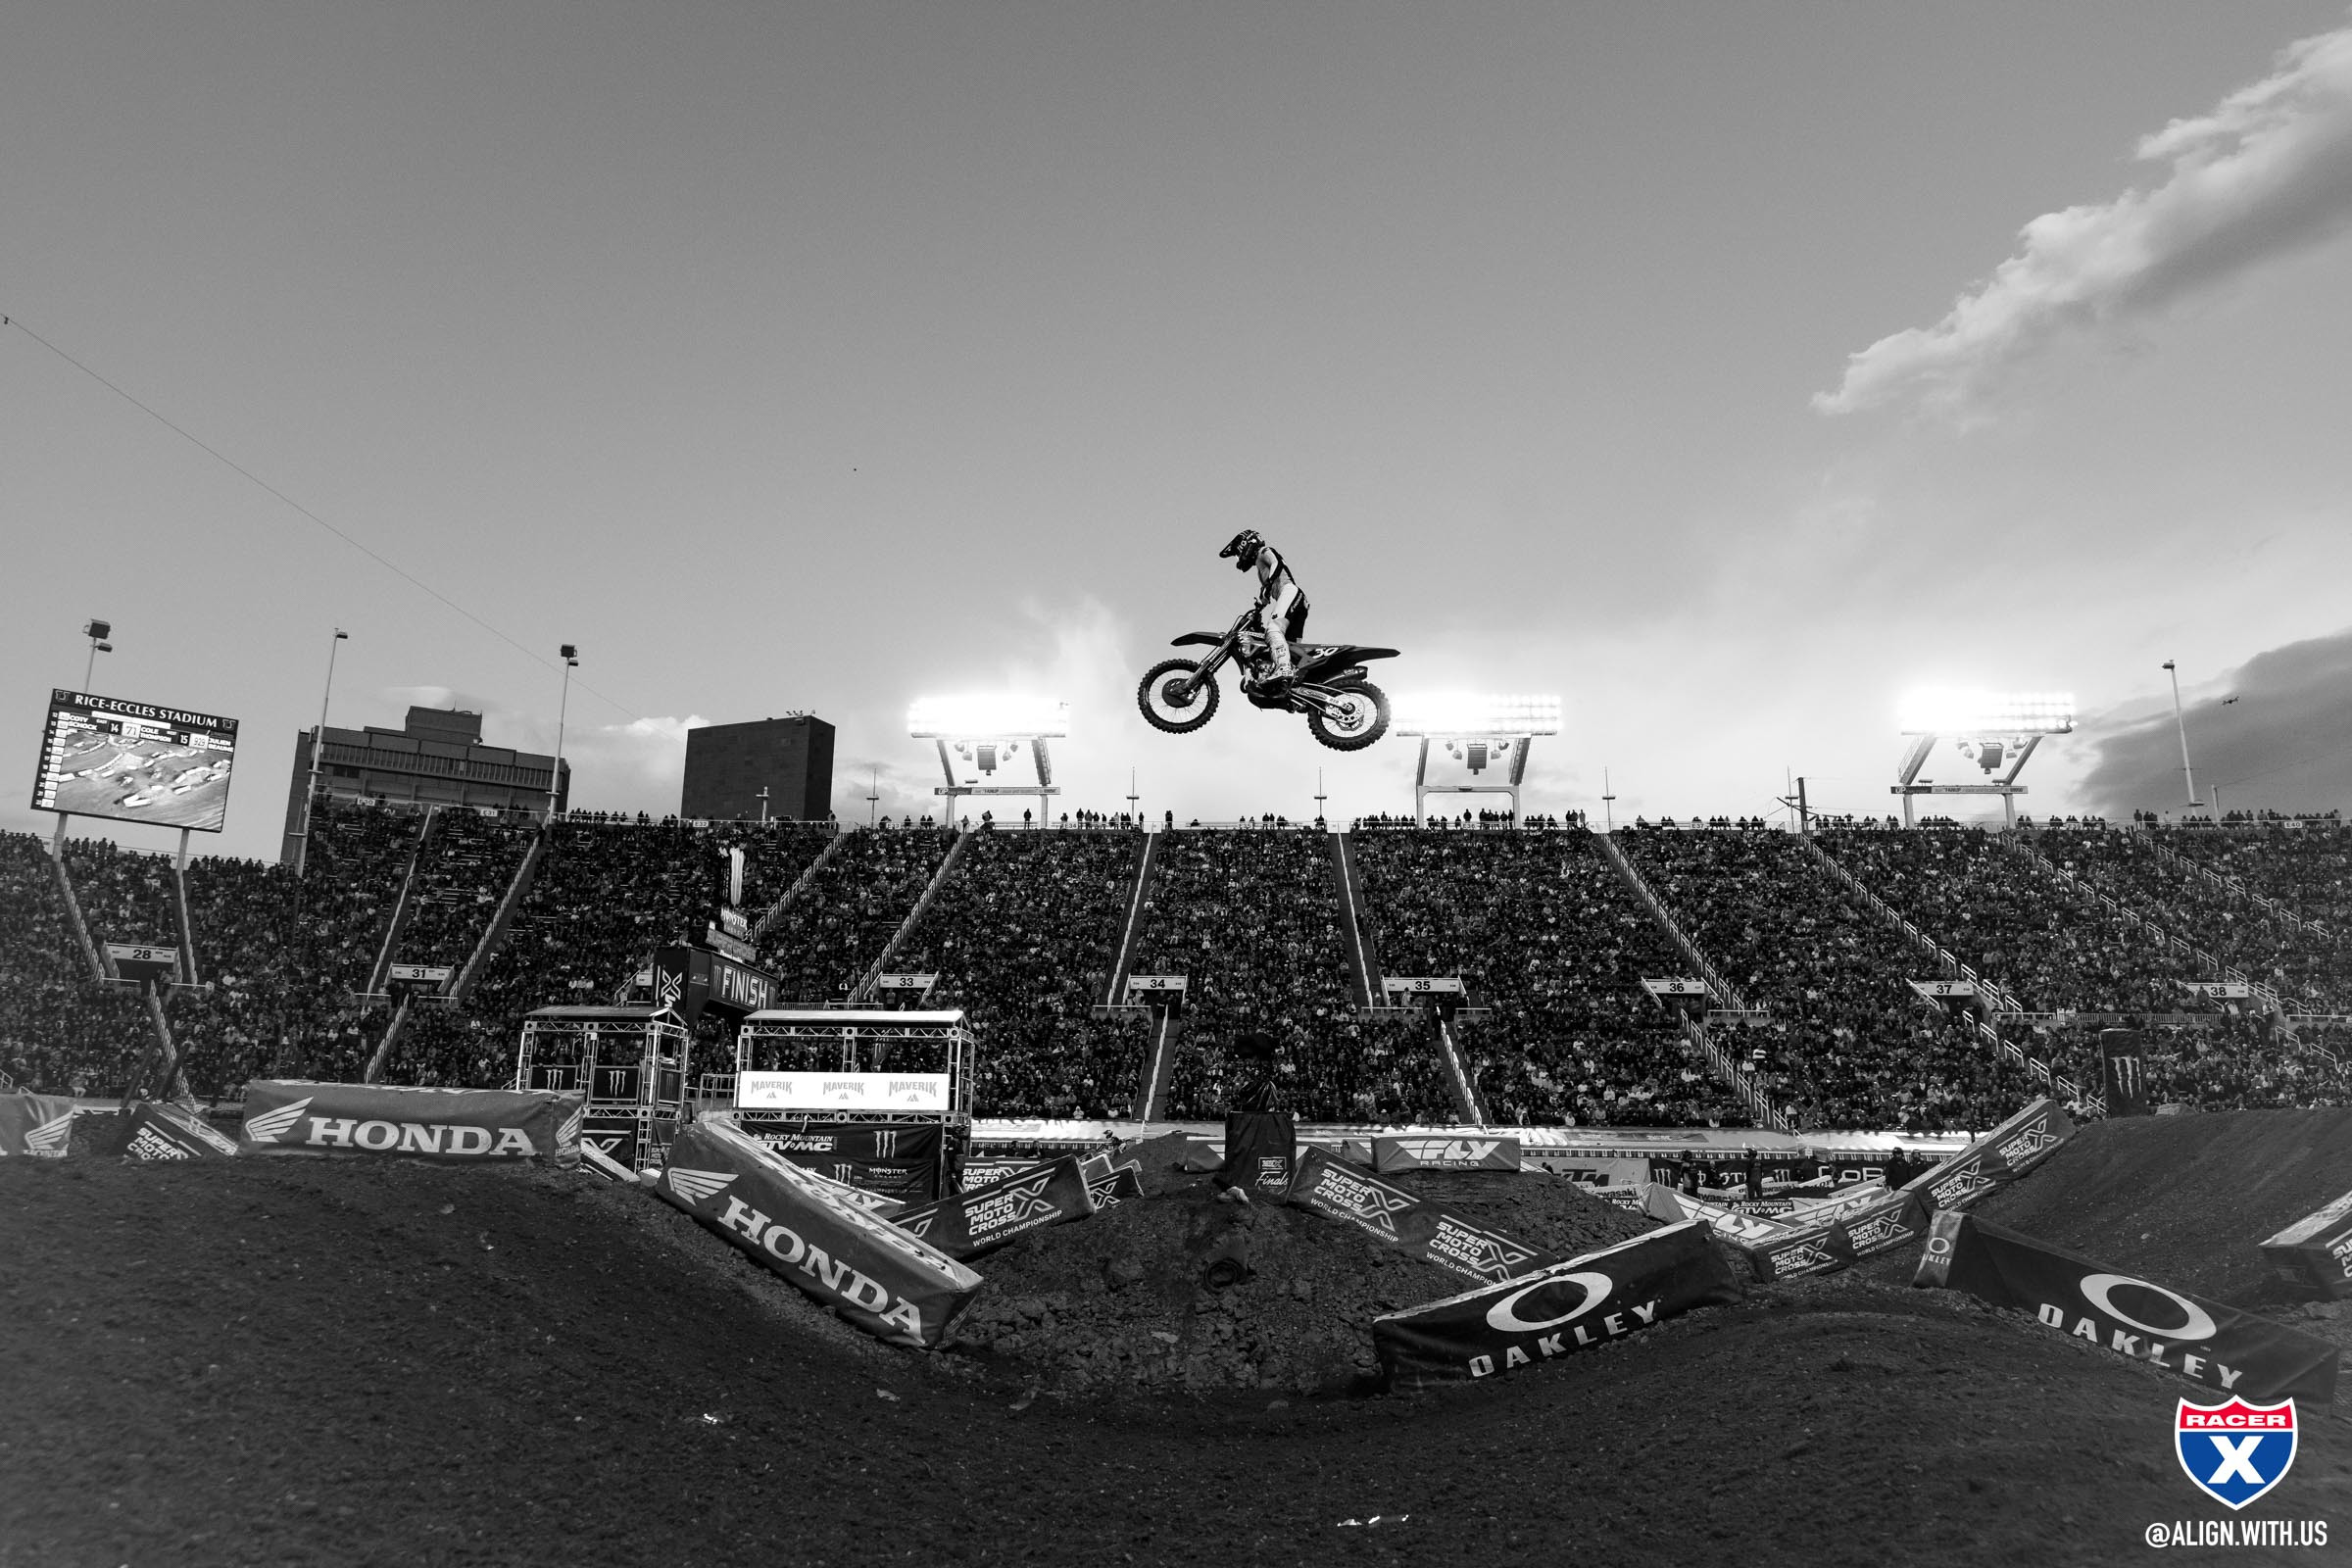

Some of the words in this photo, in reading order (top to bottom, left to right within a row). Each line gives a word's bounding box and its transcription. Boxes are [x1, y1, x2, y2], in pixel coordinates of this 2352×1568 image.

[1313, 647, 1339, 659] 30
[74, 694, 156, 717] RICE-ECCLES
[159, 710, 218, 728] STADIUM
[110, 723, 119, 733] 14
[179, 734, 188, 745] 15
[132, 949, 152, 959] 28
[412, 968, 426, 978] 31
[900, 977, 913, 987] 33
[721, 964, 768, 1009] FINISH
[1150, 979, 1165, 988] 34
[1415, 981, 1431, 990] 35
[1669, 983, 1685, 992] 36
[1936, 984, 1952, 994] 37
[2210, 987, 2227, 996] 38
[751, 1080, 792, 1095] MAVERIK
[823, 1081, 864, 1096] MAVERIK
[889, 1081, 937, 1098] MAVERIK
[137, 1127, 179, 1157] SUPER
[306, 1116, 538, 1156] HONDA
[1999, 1134, 2029, 1156] SUPER
[127, 1143, 156, 1159] CRO
[1395, 1140, 1501, 1160] FLY
[2005, 1140, 2032, 1160] MOTO
[2006, 1145, 2037, 1167] CROSS
[1255, 1171, 1289, 1187] Finals
[1321, 1168, 1371, 1197] SUPER
[1931, 1176, 1961, 1198] SUPER
[1313, 1185, 1363, 1213] CROSS
[1320, 1178, 1366, 1203] MOTO
[1936, 1182, 1964, 1201] MOTO
[1937, 1187, 1968, 1208] CROSS
[965, 1193, 1015, 1218] SUPER
[970, 1202, 1014, 1226] MOTO
[968, 1210, 1017, 1236] CROSS
[973, 1232, 1002, 1248] WORLD
[1003, 1209, 1062, 1237] CHAMPIONSHIP
[1310, 1198, 1339, 1215] WORLD
[1339, 1211, 1399, 1243] CHAMPIONSHIP
[1847, 1220, 1881, 1238] SUPER
[1436, 1221, 1488, 1250] SUPER
[1436, 1231, 1483, 1257] MOTO
[1712, 1228, 1749, 1245] CING
[1852, 1226, 1882, 1244] MOTO
[1852, 1233, 1885, 1250] CROSS
[1429, 1239, 1481, 1265] CROSS
[1771, 1248, 1804, 1263] SUPER
[1776, 1253, 1804, 1268] MOTO
[717, 1195, 926, 1345] HONDA
[1426, 1251, 1455, 1270] WORLD
[1455, 1265, 1496, 1287] CHAMPIO
[1775, 1259, 1808, 1275] CROSS
[1469, 1300, 1654, 1377] OAKLEY
[2037, 1302, 2243, 1390] OAKLEY
